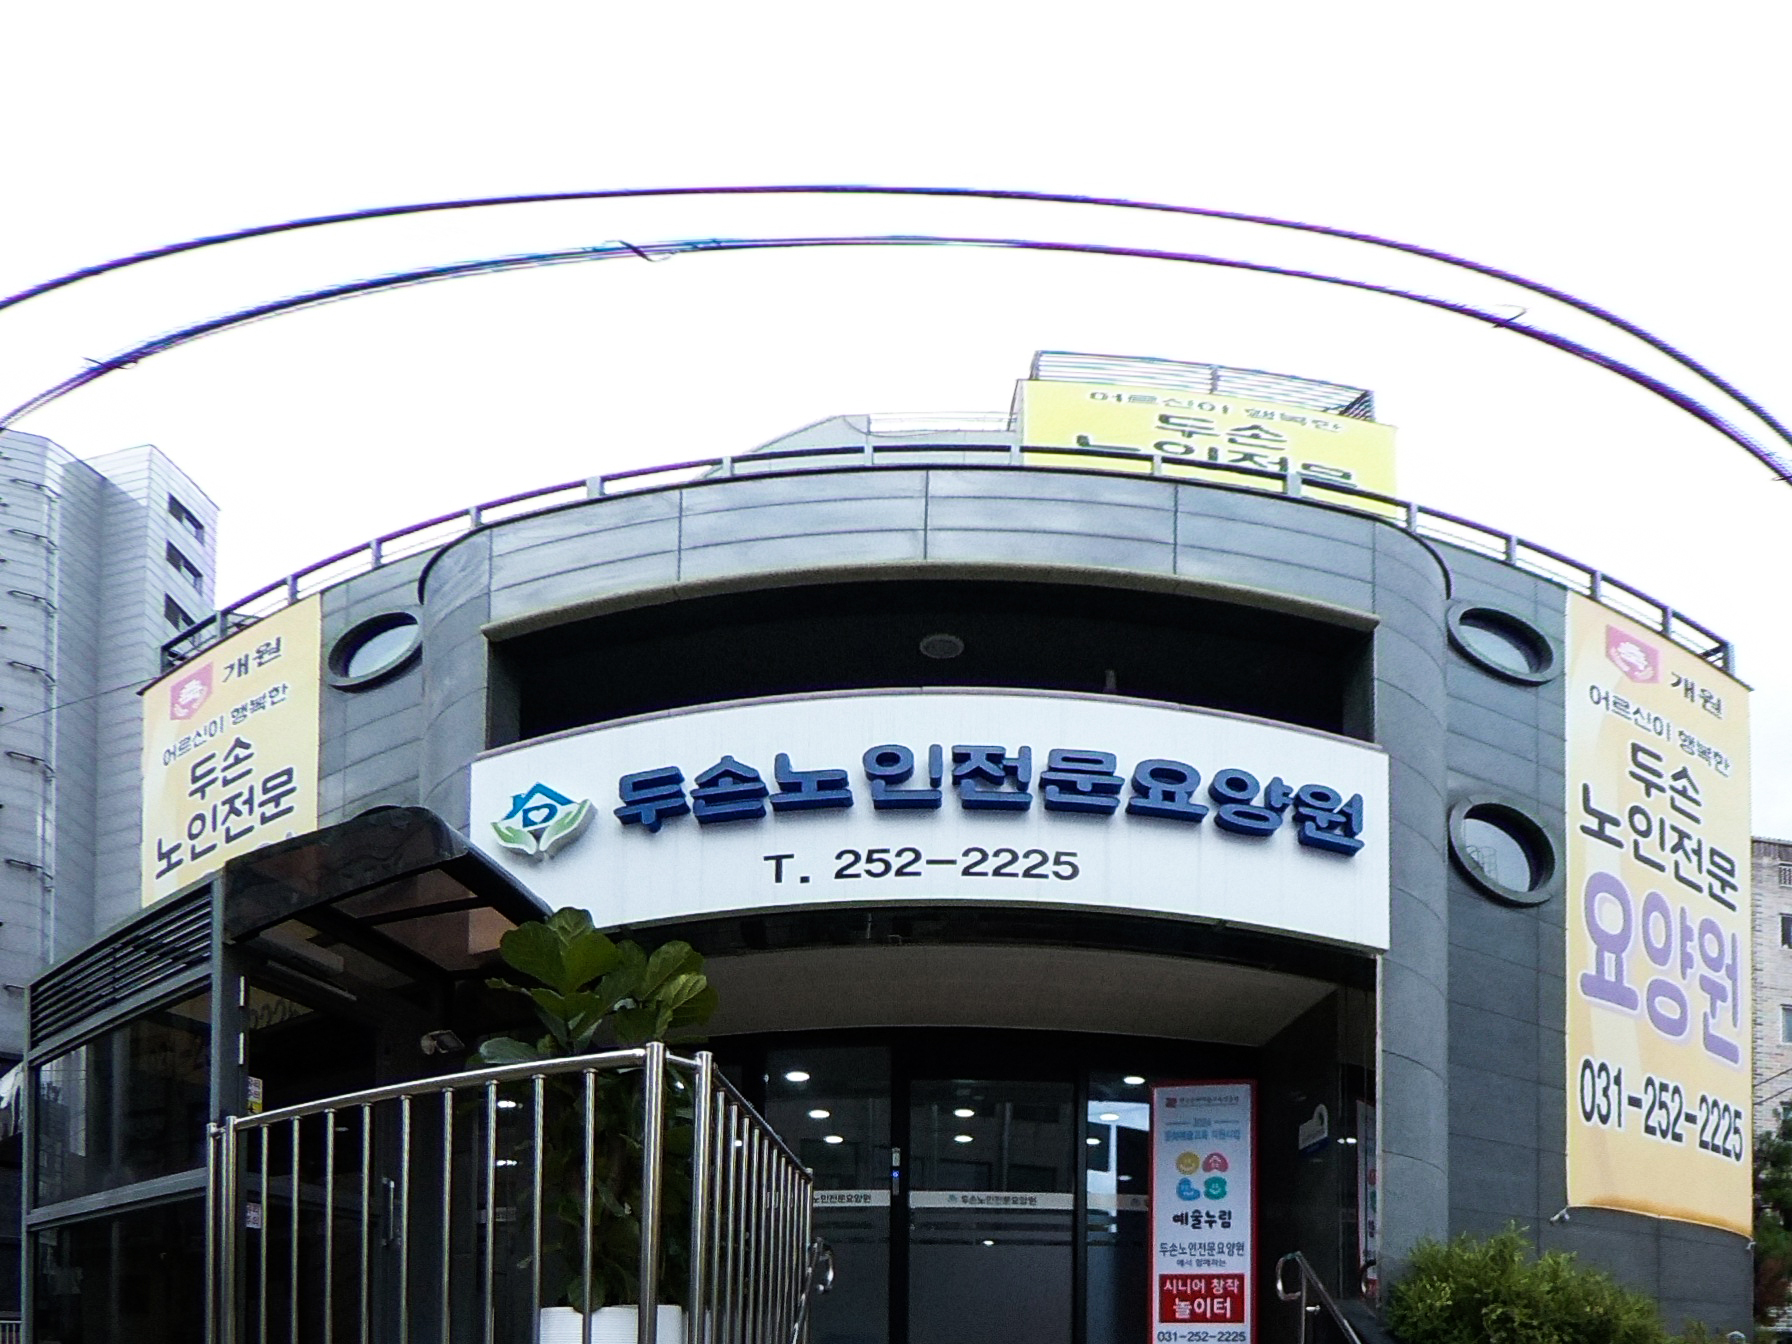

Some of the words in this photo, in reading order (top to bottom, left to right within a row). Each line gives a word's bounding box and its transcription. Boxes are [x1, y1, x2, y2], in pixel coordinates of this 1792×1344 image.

[1090, 391, 1230, 415] 어르신이
[1155, 414, 1287, 451] 두손
[222, 637, 282, 683] 개원
[1671, 671, 1724, 720] 개원
[163, 716, 224, 765] 어르신이
[230, 683, 289, 726] 행복한
[1589, 685, 1672, 742] 어르신이
[1677, 729, 1730, 778] 행복한
[188, 737, 254, 800] 두손
[1628, 742, 1702, 825] 두손
[155, 767, 298, 880] 노인전문
[613, 744, 1365, 858] 두손노인전문요양원
[763, 853, 810, 884] T.
[834, 846, 1080, 883] 252-2225
[1579, 783, 1739, 912] 노인전문
[1579, 871, 1740, 1065] 요양원
[1580, 1058, 1744, 1162] 031-252-2225
[1172, 1209, 1232, 1229] 예술누림
[1159, 1241, 1245, 1256] 두손노인전문요양원
[1163, 1279, 1206, 1294] 시니어
[1211, 1278, 1239, 1294] 창작
[1173, 1297, 1231, 1319] 놀이터
[1157, 1331, 1246, 1342] 031-252-2225
